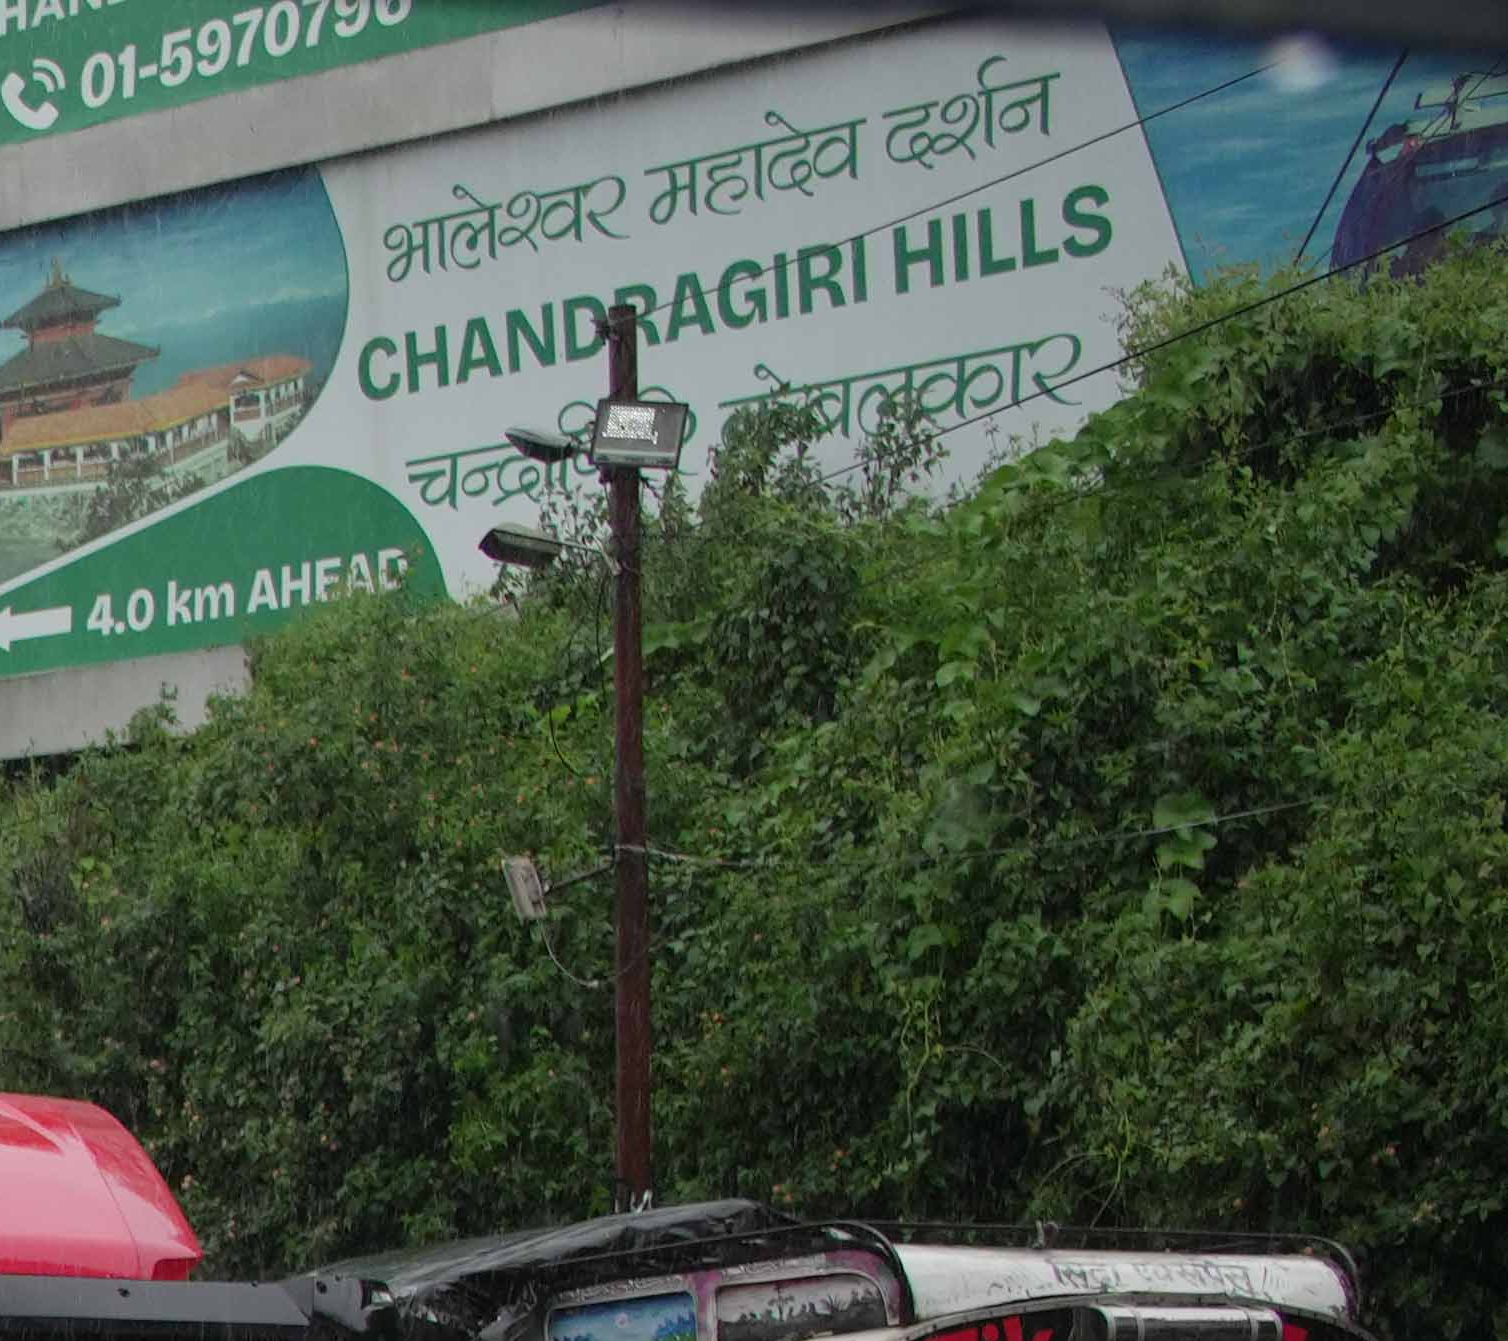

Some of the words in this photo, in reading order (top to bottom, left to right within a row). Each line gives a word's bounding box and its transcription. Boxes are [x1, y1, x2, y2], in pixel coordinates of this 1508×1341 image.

[381, 175, 627, 283] भालेश्वर
[645, 110, 867, 225] महादेव
[883, 55, 1062, 169] दर्शन
[894, 183, 1115, 296] HILLS
[86, 587, 155, 636] 4.0
[167, 579, 235, 627] km
